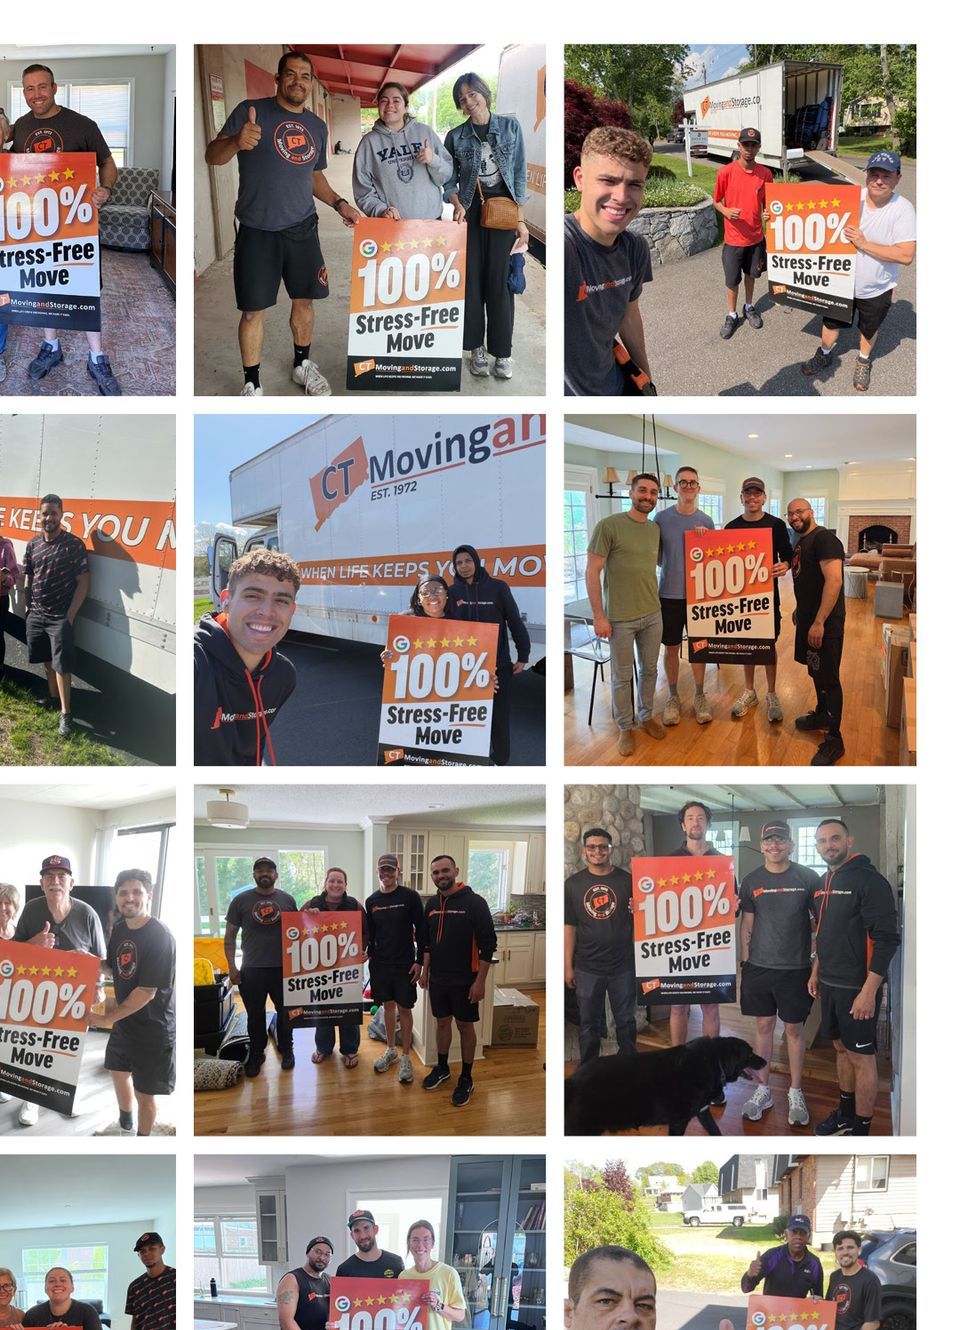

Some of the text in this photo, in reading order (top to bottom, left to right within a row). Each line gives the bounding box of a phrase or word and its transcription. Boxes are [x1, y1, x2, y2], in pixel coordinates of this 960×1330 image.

[770, 212, 851, 250] 100%
[772, 255, 851, 271] Stress-Free
[20, 266, 69, 288] Move
[358, 250, 460, 307] 100%
[793, 272, 829, 286] Move
[11, 299, 96, 311] MovingandStorage.com
[356, 305, 459, 335] Stress-Free
[386, 330, 434, 353] Move
[376, 364, 456, 373] MovingandStorage.com
[322, 459, 354, 500] CT
[371, 481, 417, 501] EST. 1972
[82, 514, 149, 546] YOU
[301, 562, 429, 579] WHEN LIFE KEEPS
[691, 551, 768, 600] 100%
[691, 597, 770, 621] Stress-Free
[715, 617, 752, 635] Move
[391, 651, 489, 700] 100%
[387, 703, 487, 725] Stress-Free
[415, 726, 462, 745] Move
[640, 882, 729, 935] 100%
[287, 932, 358, 973] 100%
[641, 930, 731, 958] Stress-Free
[669, 952, 710, 973] Move
[288, 968, 359, 992] Stress-Free
[661, 980, 731, 989] MovingandStorage.com
[310, 986, 343, 1002] Move
[11, 1047, 53, 1069] Move
[0, 1069, 70, 1096] MovingandStorage.com
